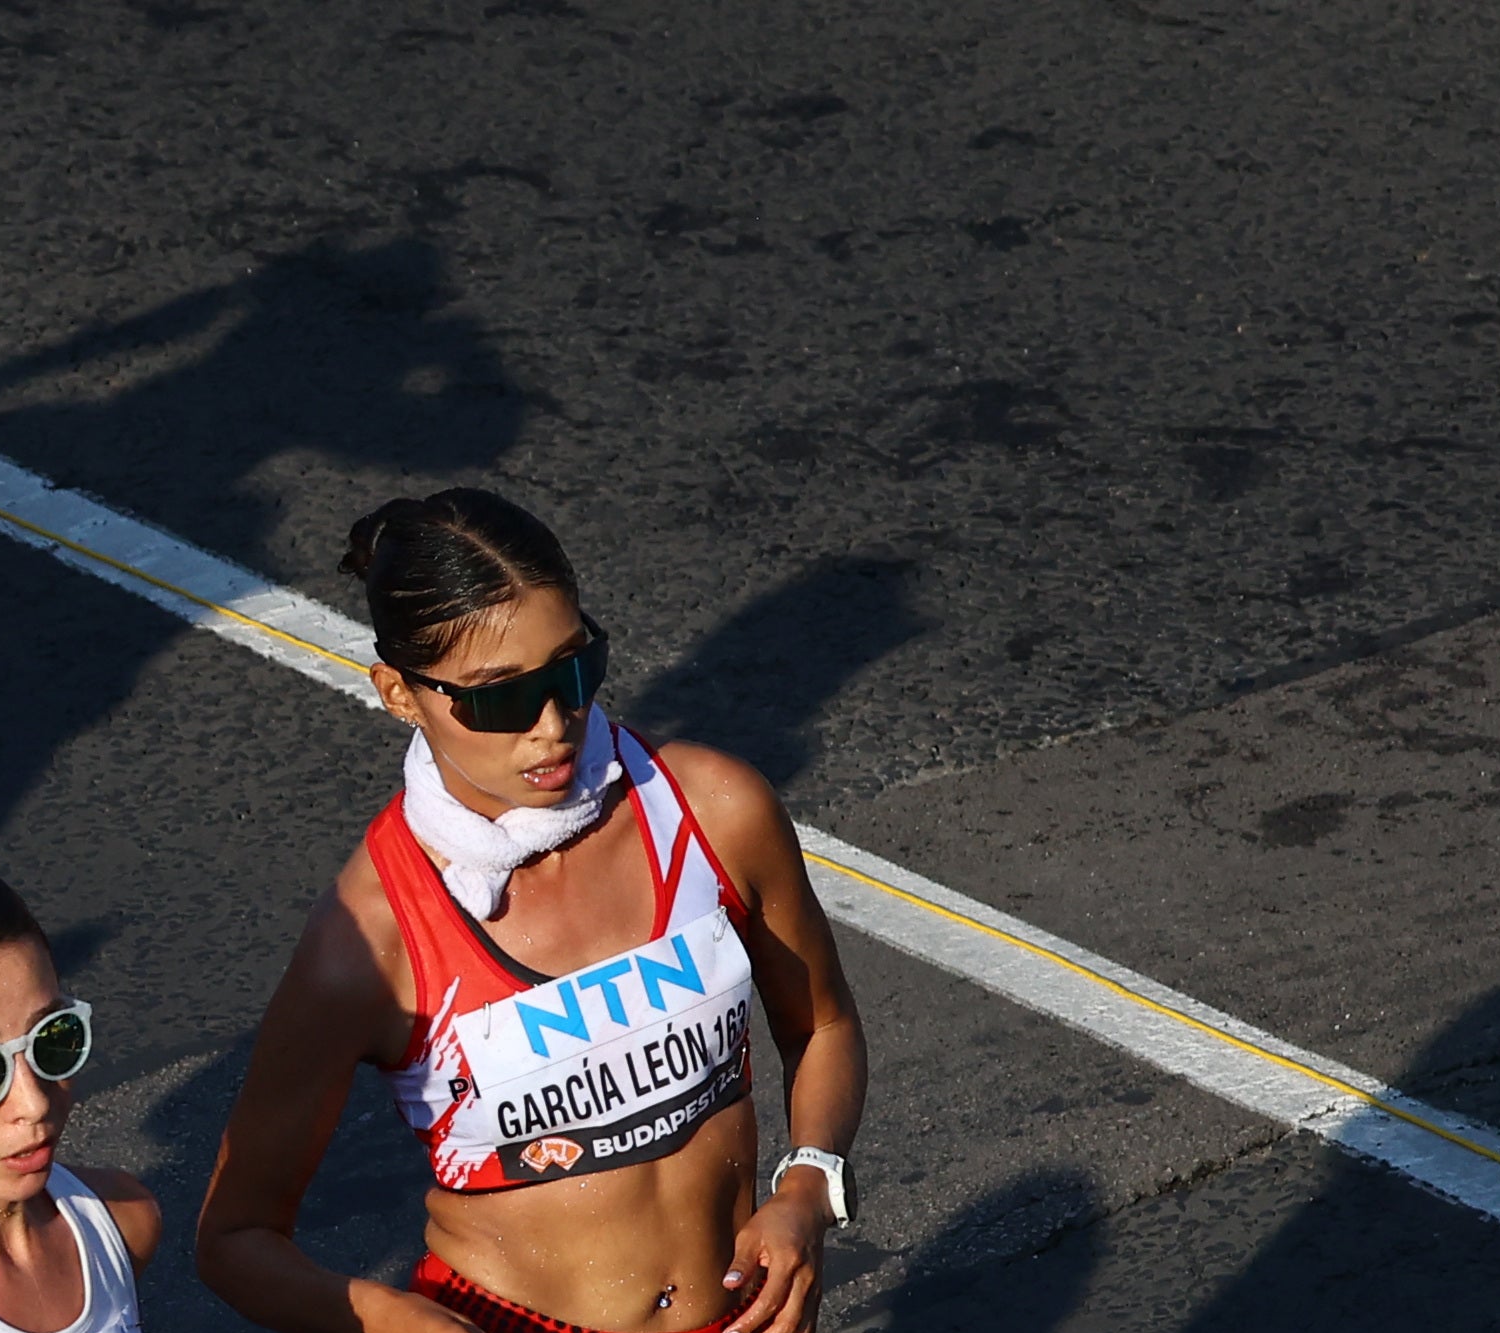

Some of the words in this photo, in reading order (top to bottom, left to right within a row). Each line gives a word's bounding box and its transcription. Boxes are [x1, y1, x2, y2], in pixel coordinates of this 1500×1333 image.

[513, 933, 707, 1059] NTN
[496, 1057, 626, 1140] GARCÍA
[625, 1022, 716, 1097] LEÓN
[713, 999, 747, 1058] 163
[592, 1086, 718, 1159] BUDAPEST
